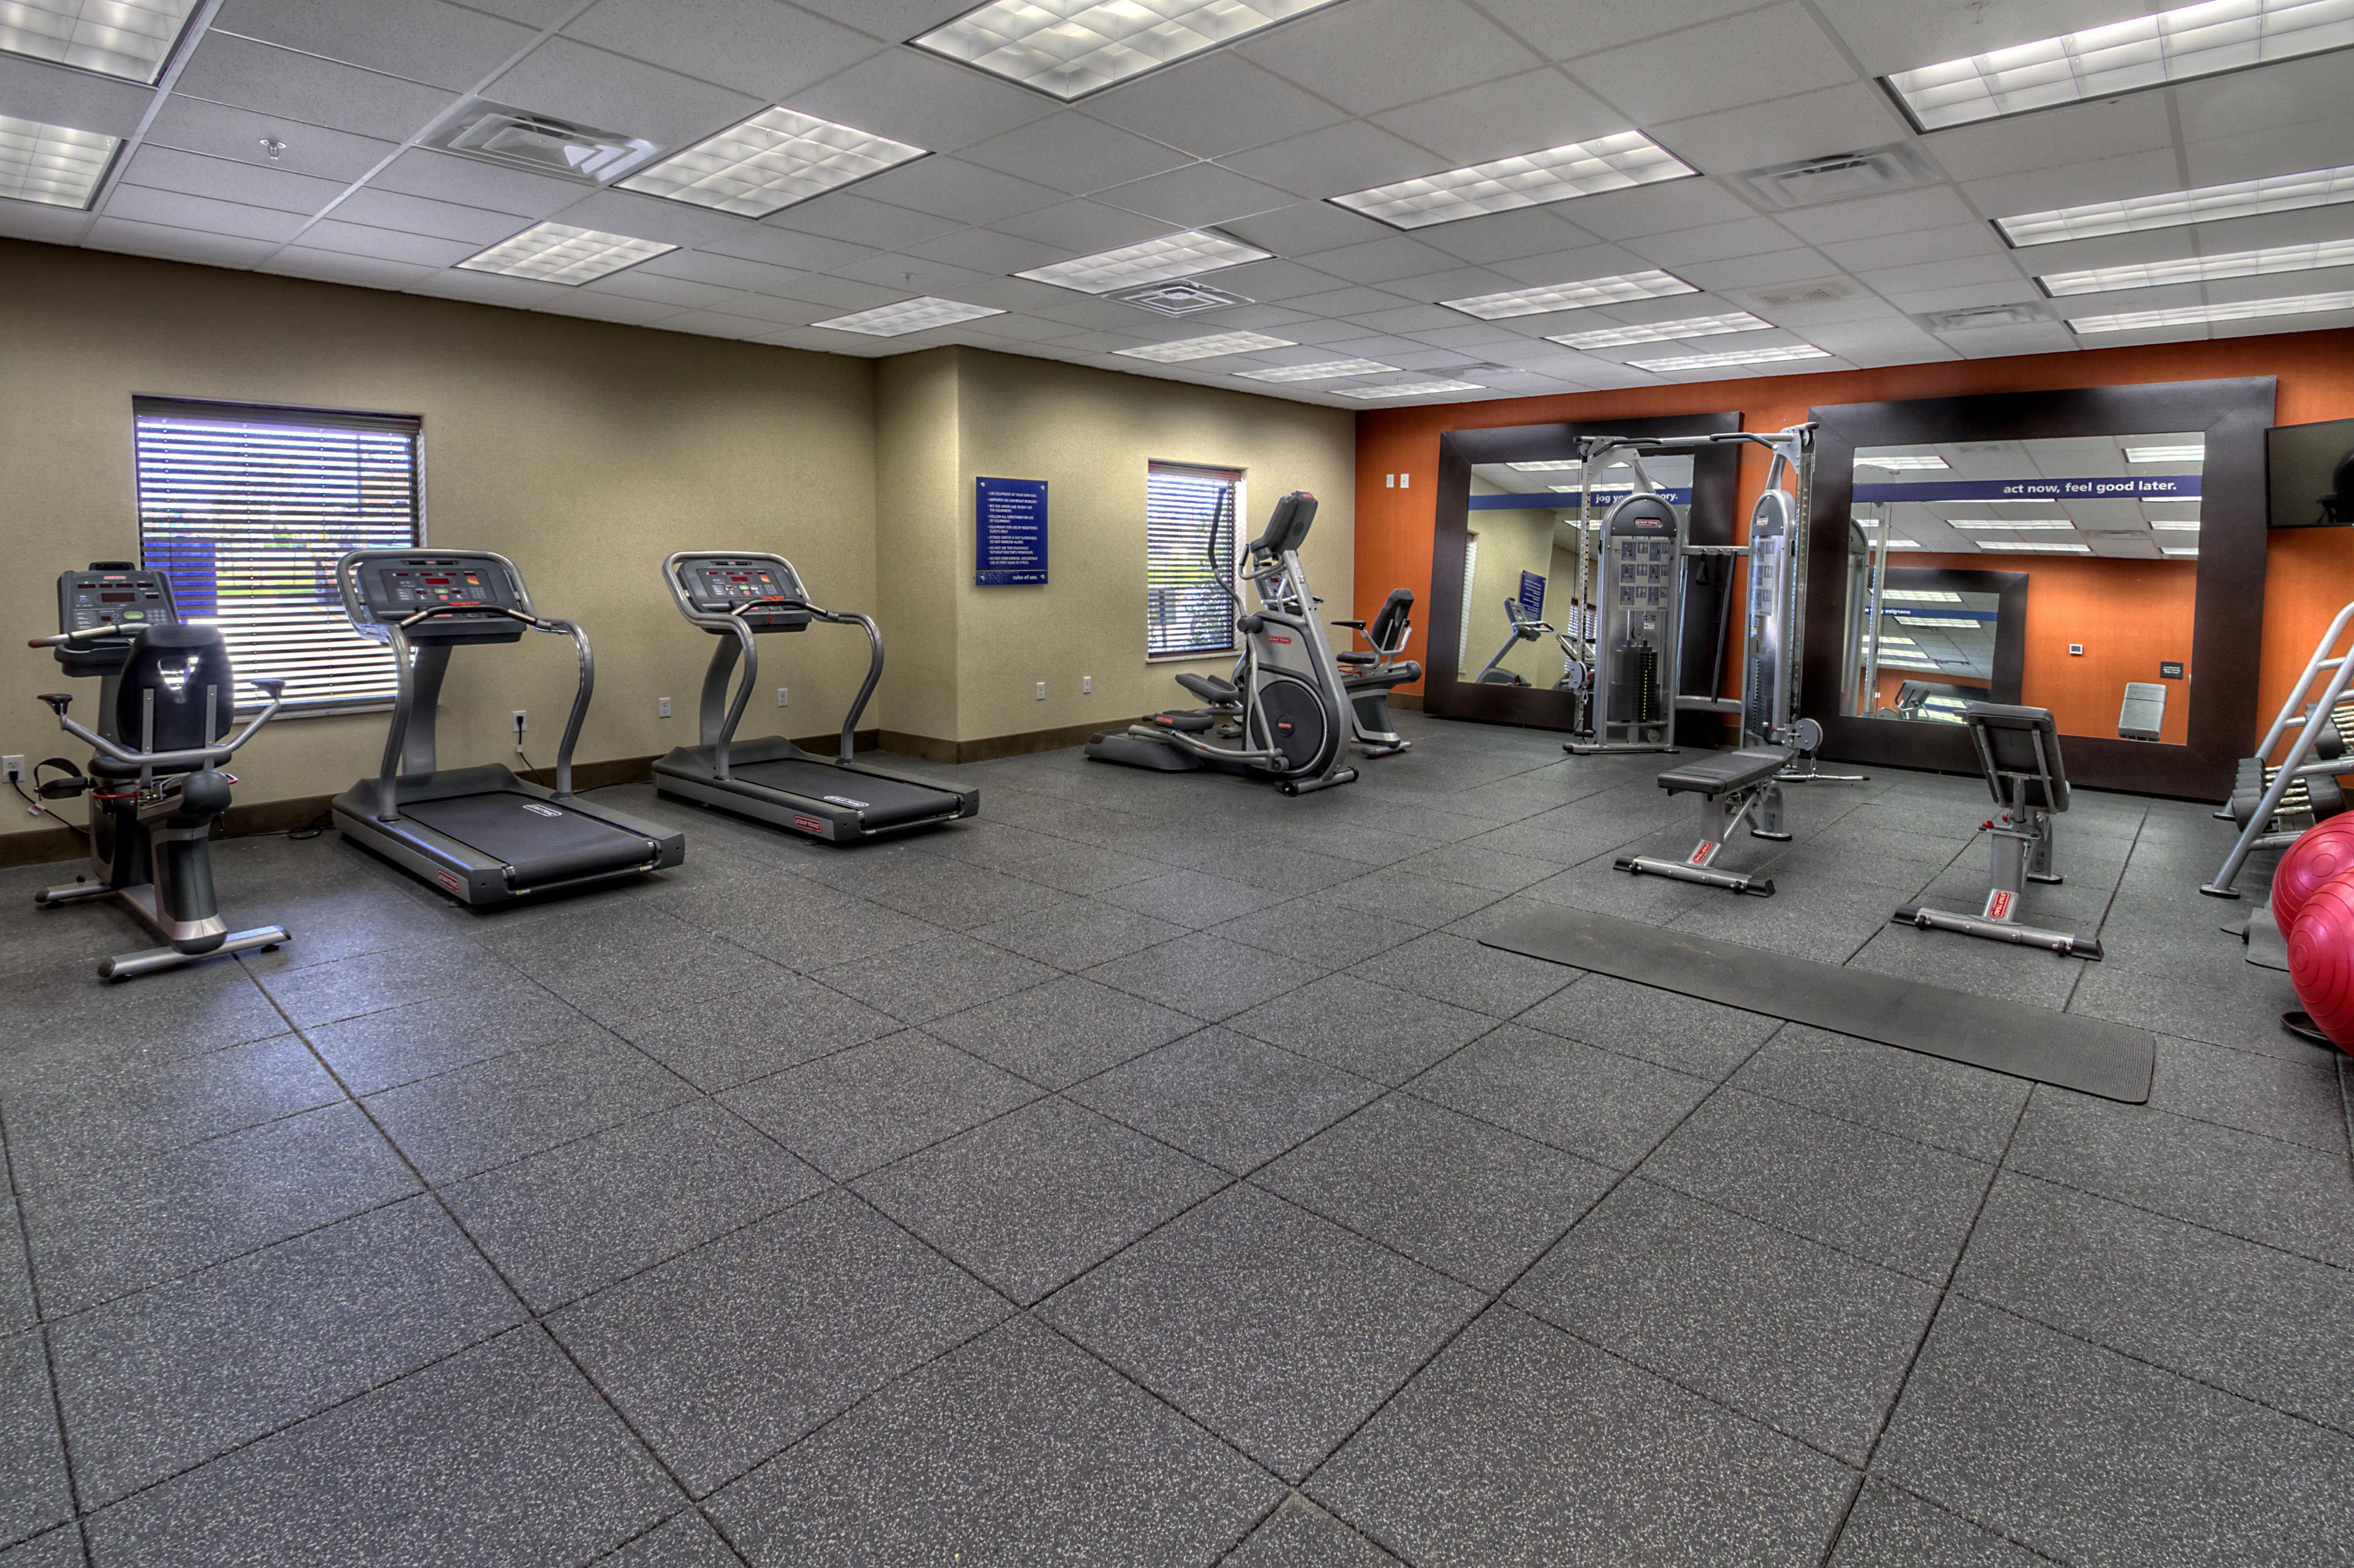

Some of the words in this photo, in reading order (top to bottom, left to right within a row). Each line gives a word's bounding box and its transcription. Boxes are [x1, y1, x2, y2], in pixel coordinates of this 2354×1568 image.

[2003, 484, 2024, 493] act
[2027, 484, 2060, 493] now,
[2065, 482, 2092, 492] feel
[2097, 481, 2134, 493] good
[2138, 481, 2177, 491] later.
[1595, 494, 1611, 503] jog
[1994, 905, 2003, 916] TRAC
